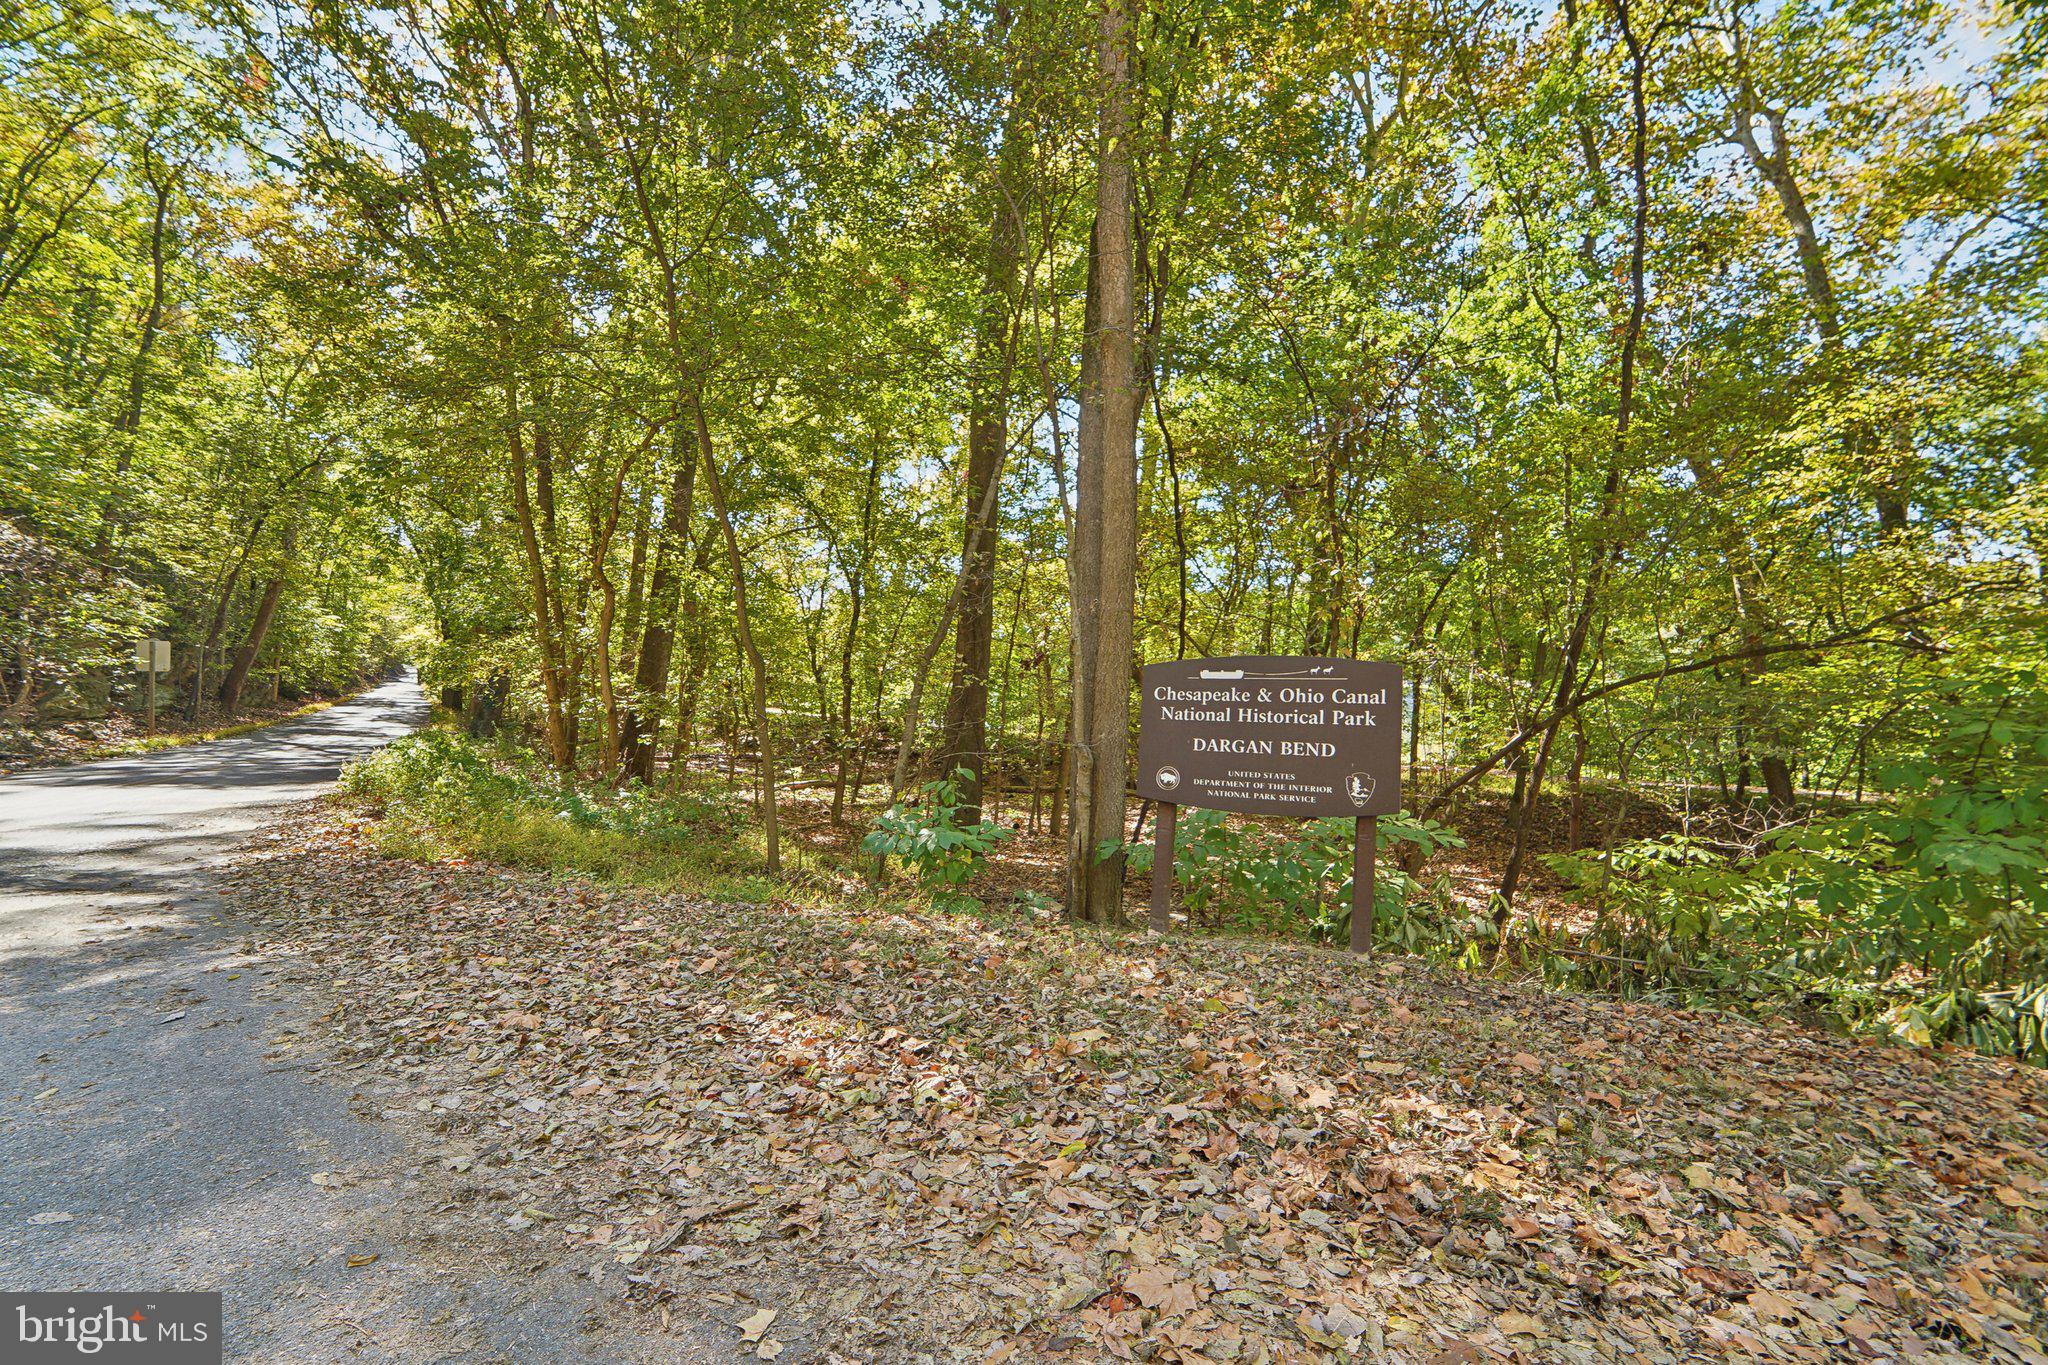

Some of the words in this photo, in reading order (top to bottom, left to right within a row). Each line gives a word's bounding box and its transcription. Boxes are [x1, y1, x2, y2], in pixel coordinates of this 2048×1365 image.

[1154, 686, 1250, 705] Chesapeake
[1257, 688, 1272, 702] &
[1279, 688, 1324, 704] Ohio
[1332, 689, 1387, 704] Canal
[1161, 707, 1230, 722] National
[1238, 708, 1324, 724] Historical
[1332, 710, 1376, 726] Park
[1193, 738, 1272, 755] DARGAN
[1281, 742, 1336, 757] BEND
[1228, 771, 1261, 779] UNITED
[1263, 772, 1295, 780] STATES
[1193, 778, 1250, 788] DEPARTMENT
[1253, 781, 1264, 789] OF
[1267, 782, 1286, 790] THE
[1289, 784, 1332, 794] INTERIOR
[1207, 790, 1250, 799] NATIONAL
[1253, 793, 1276, 801] PARK
[1278, 795, 1316, 803] SERVICE
